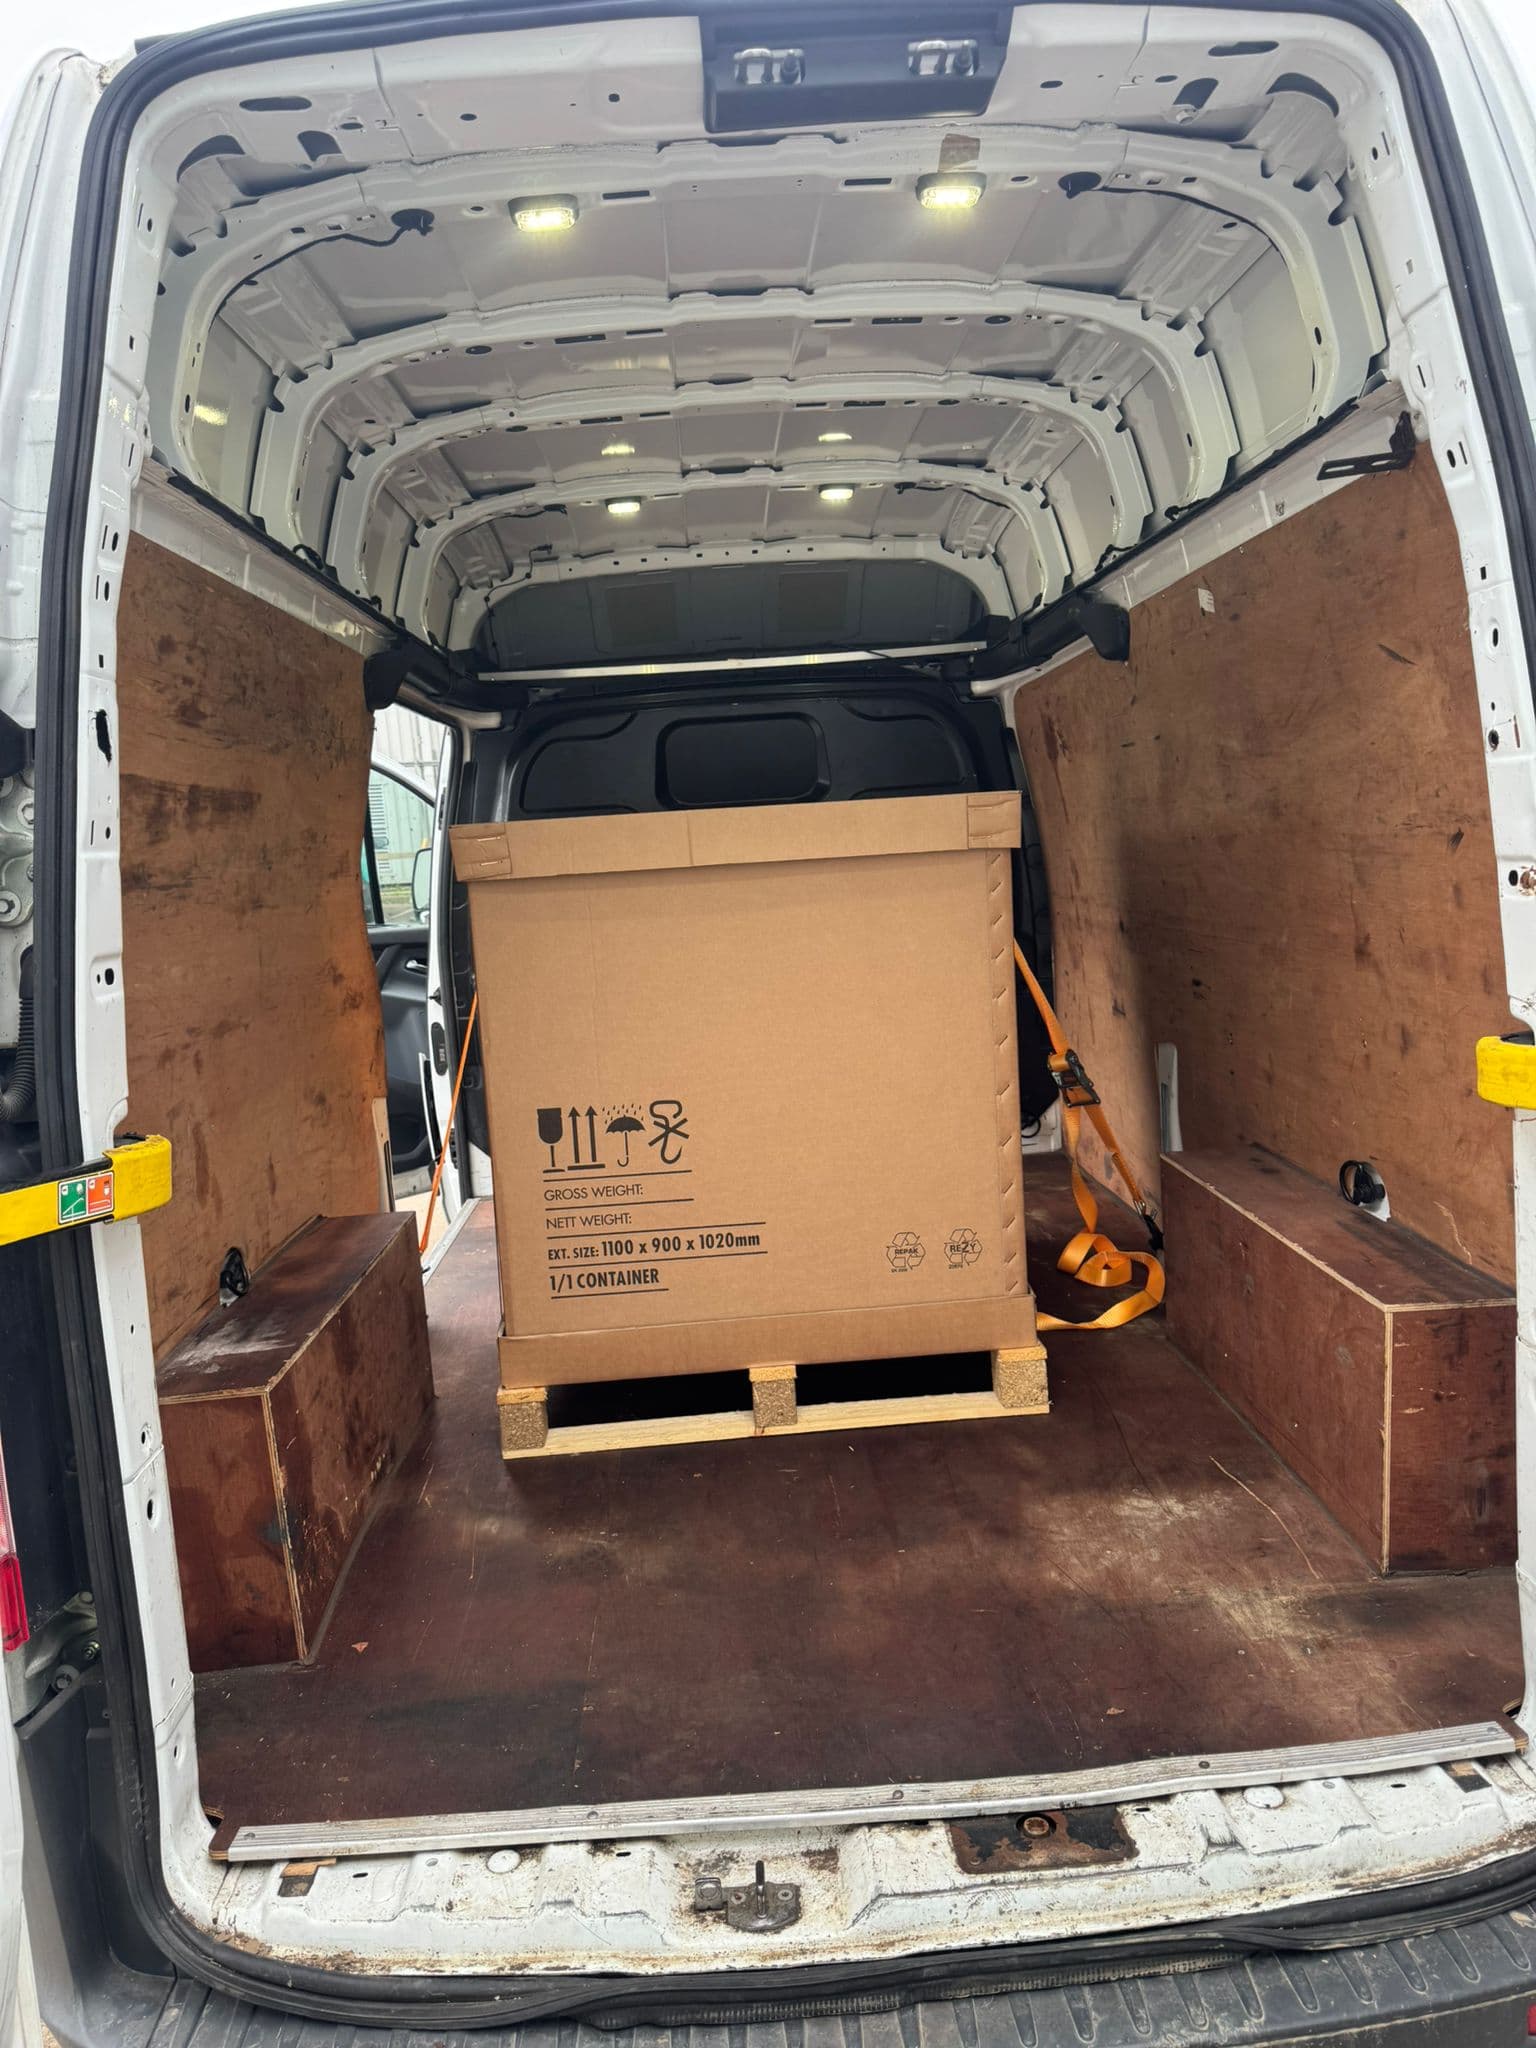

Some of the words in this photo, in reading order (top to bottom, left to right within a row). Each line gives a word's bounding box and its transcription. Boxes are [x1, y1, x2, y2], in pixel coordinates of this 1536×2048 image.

[544, 1187, 588, 1201] GROSS
[591, 1184, 644, 1198] WEIGHT:
[546, 1216, 576, 1230] NETT
[580, 1213, 632, 1227] WEIGHT:
[548, 1248, 571, 1261] EXT.
[574, 1246, 599, 1259] SIZE:
[601, 1240, 634, 1257] 1100
[639, 1242, 648, 1254] x
[651, 1236, 681, 1252] 900
[686, 1239, 695, 1250] x
[699, 1232, 760, 1250] 1020mm
[895, 1247, 919, 1255] REPAK
[949, 1241, 976, 1253] REZY
[550, 1274, 573, 1293] 1/1
[577, 1268, 660, 1289] CONTAINER
